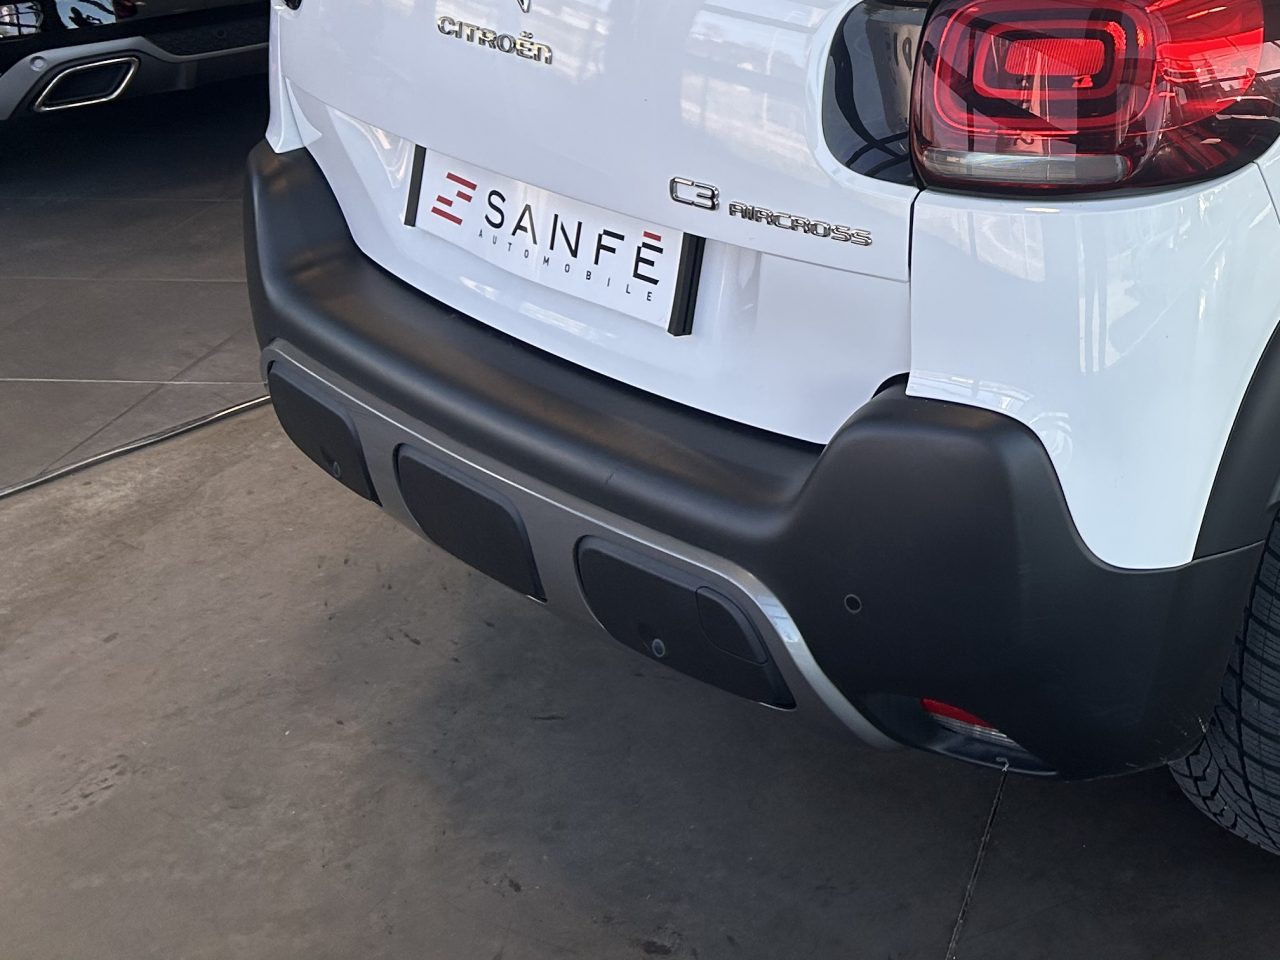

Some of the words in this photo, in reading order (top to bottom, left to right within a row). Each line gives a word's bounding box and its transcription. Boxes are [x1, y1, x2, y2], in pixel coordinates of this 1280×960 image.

[669, 176, 720, 211] C3
[728, 201, 873, 246] AIRCROSS
[477, 228, 653, 302] AUTOMOBILE
